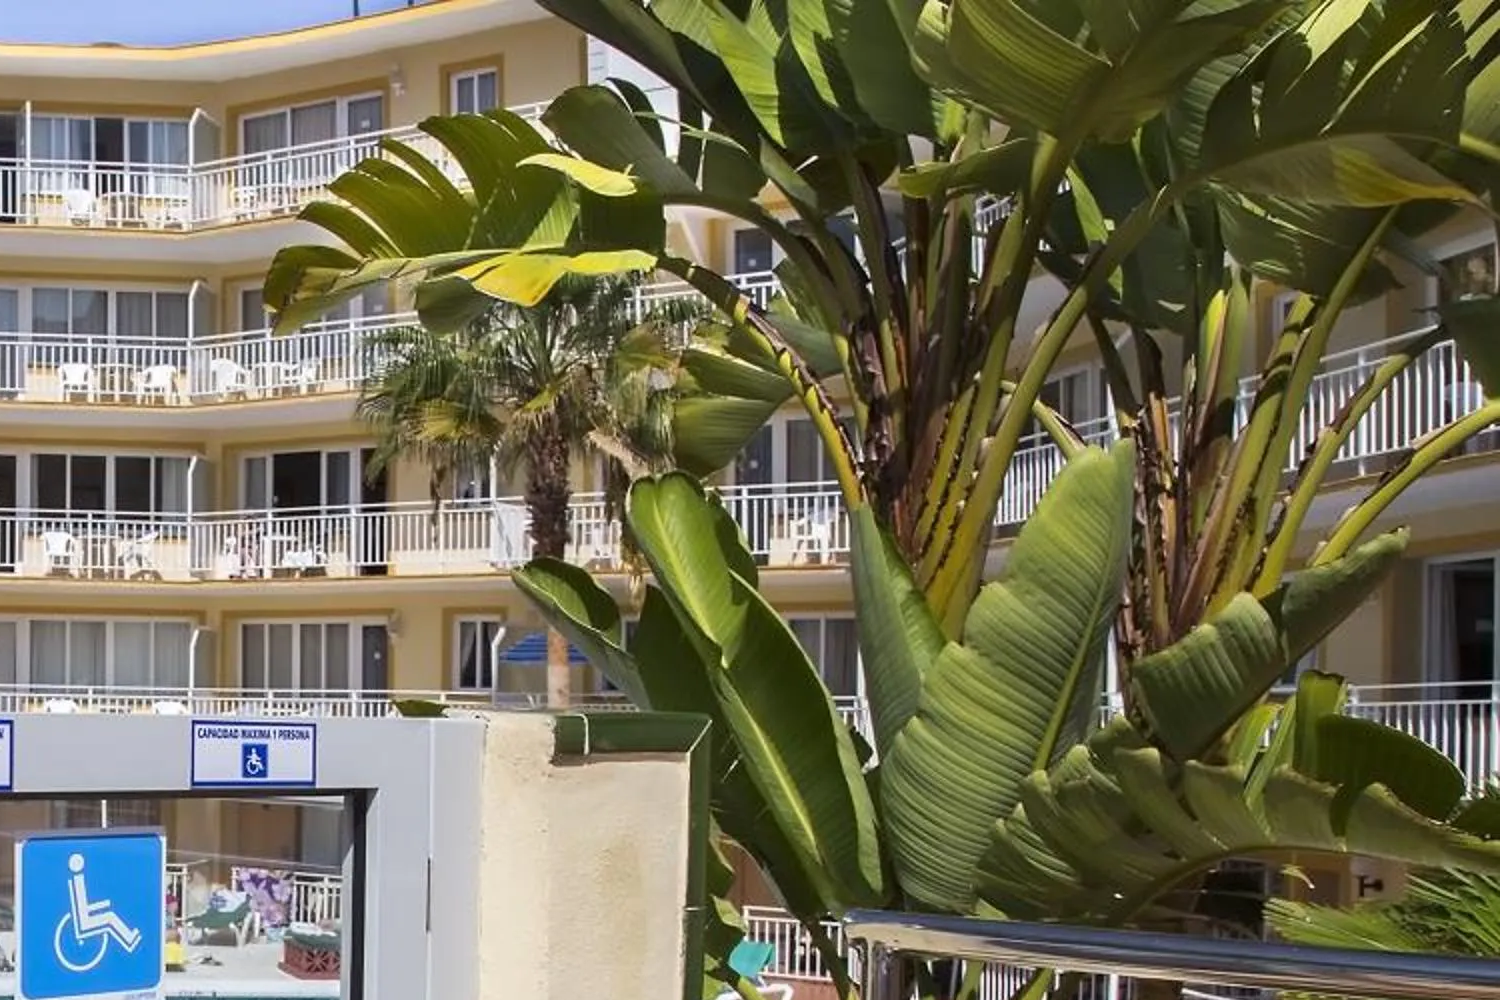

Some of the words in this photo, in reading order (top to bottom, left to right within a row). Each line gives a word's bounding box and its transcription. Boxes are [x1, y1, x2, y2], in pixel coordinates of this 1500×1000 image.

[197, 728, 239, 739] CAPACIDAD
[273, 730, 277, 739] 1
[278, 730, 310, 740] PERSONA
